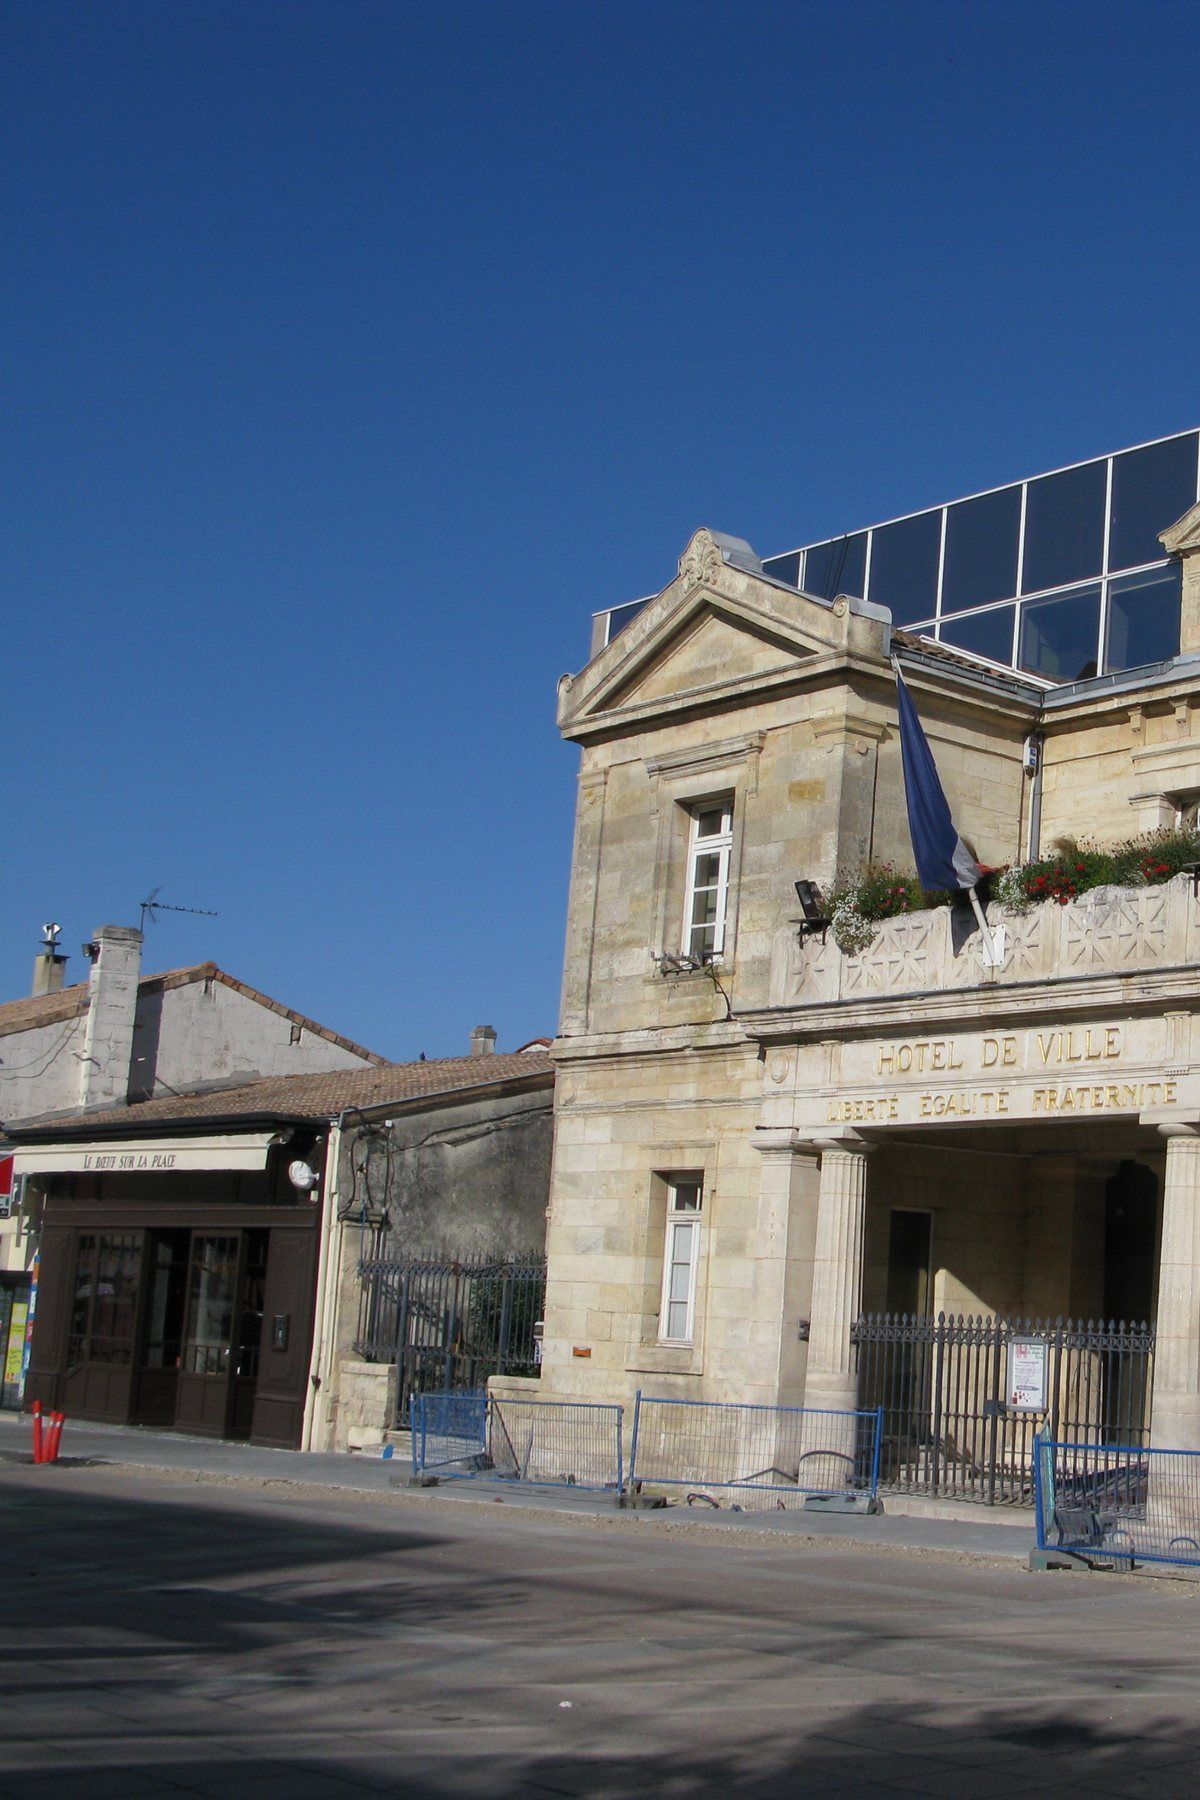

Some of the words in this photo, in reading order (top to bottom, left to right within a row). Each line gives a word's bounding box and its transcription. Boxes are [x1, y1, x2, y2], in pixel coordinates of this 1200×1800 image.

[877, 1041, 963, 1075] HOTEL
[981, 1036, 1017, 1068] DE
[1037, 1027, 1121, 1064] VILLE
[827, 1094, 899, 1122] LIBERTÉ
[919, 1088, 1009, 1117] ÉGALITÉ
[1032, 1077, 1178, 1112] FRATERNITÉ
[119, 1155, 135, 1168] SUR
[137, 1155, 148, 1168] LA
[151, 1154, 176, 1168] PLACE
